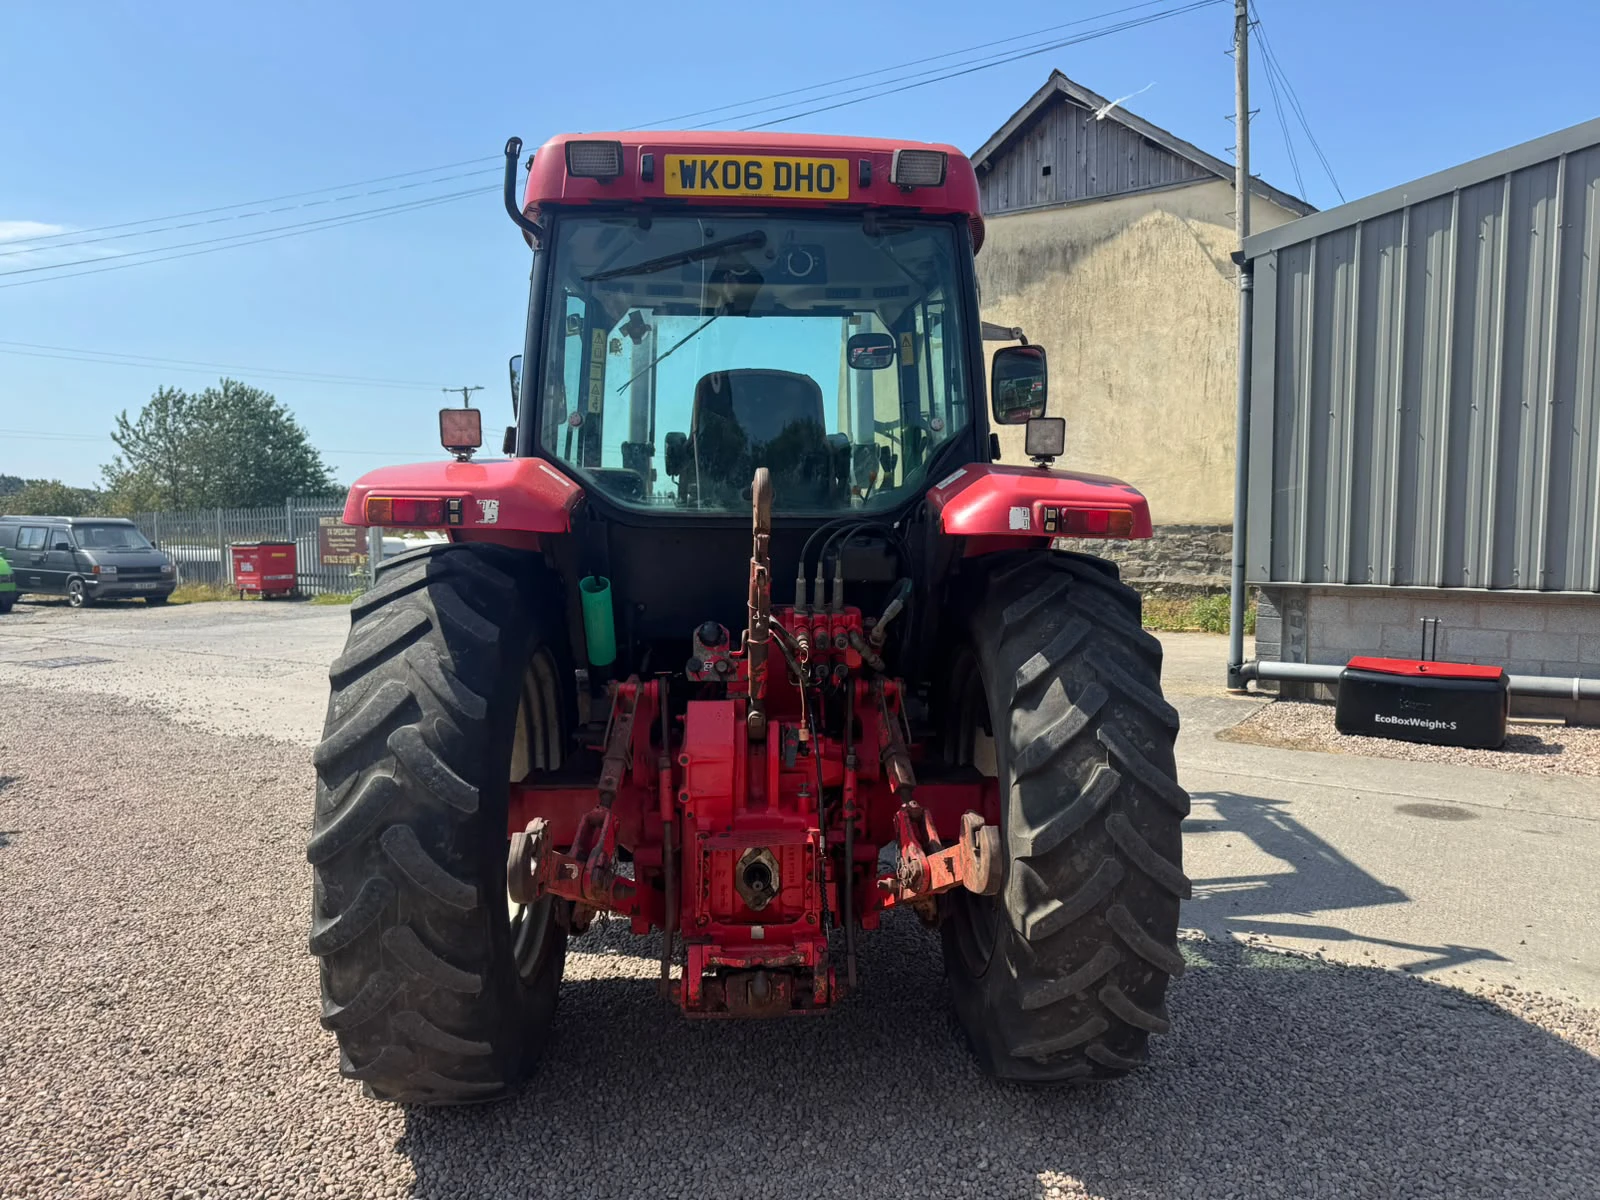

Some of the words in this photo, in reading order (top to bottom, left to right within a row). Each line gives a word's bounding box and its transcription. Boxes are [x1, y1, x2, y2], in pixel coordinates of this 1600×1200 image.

[679, 159, 763, 190] WK06
[773, 161, 836, 193] DHO
[1375, 714, 1457, 730] EcoBoxWeight-S
